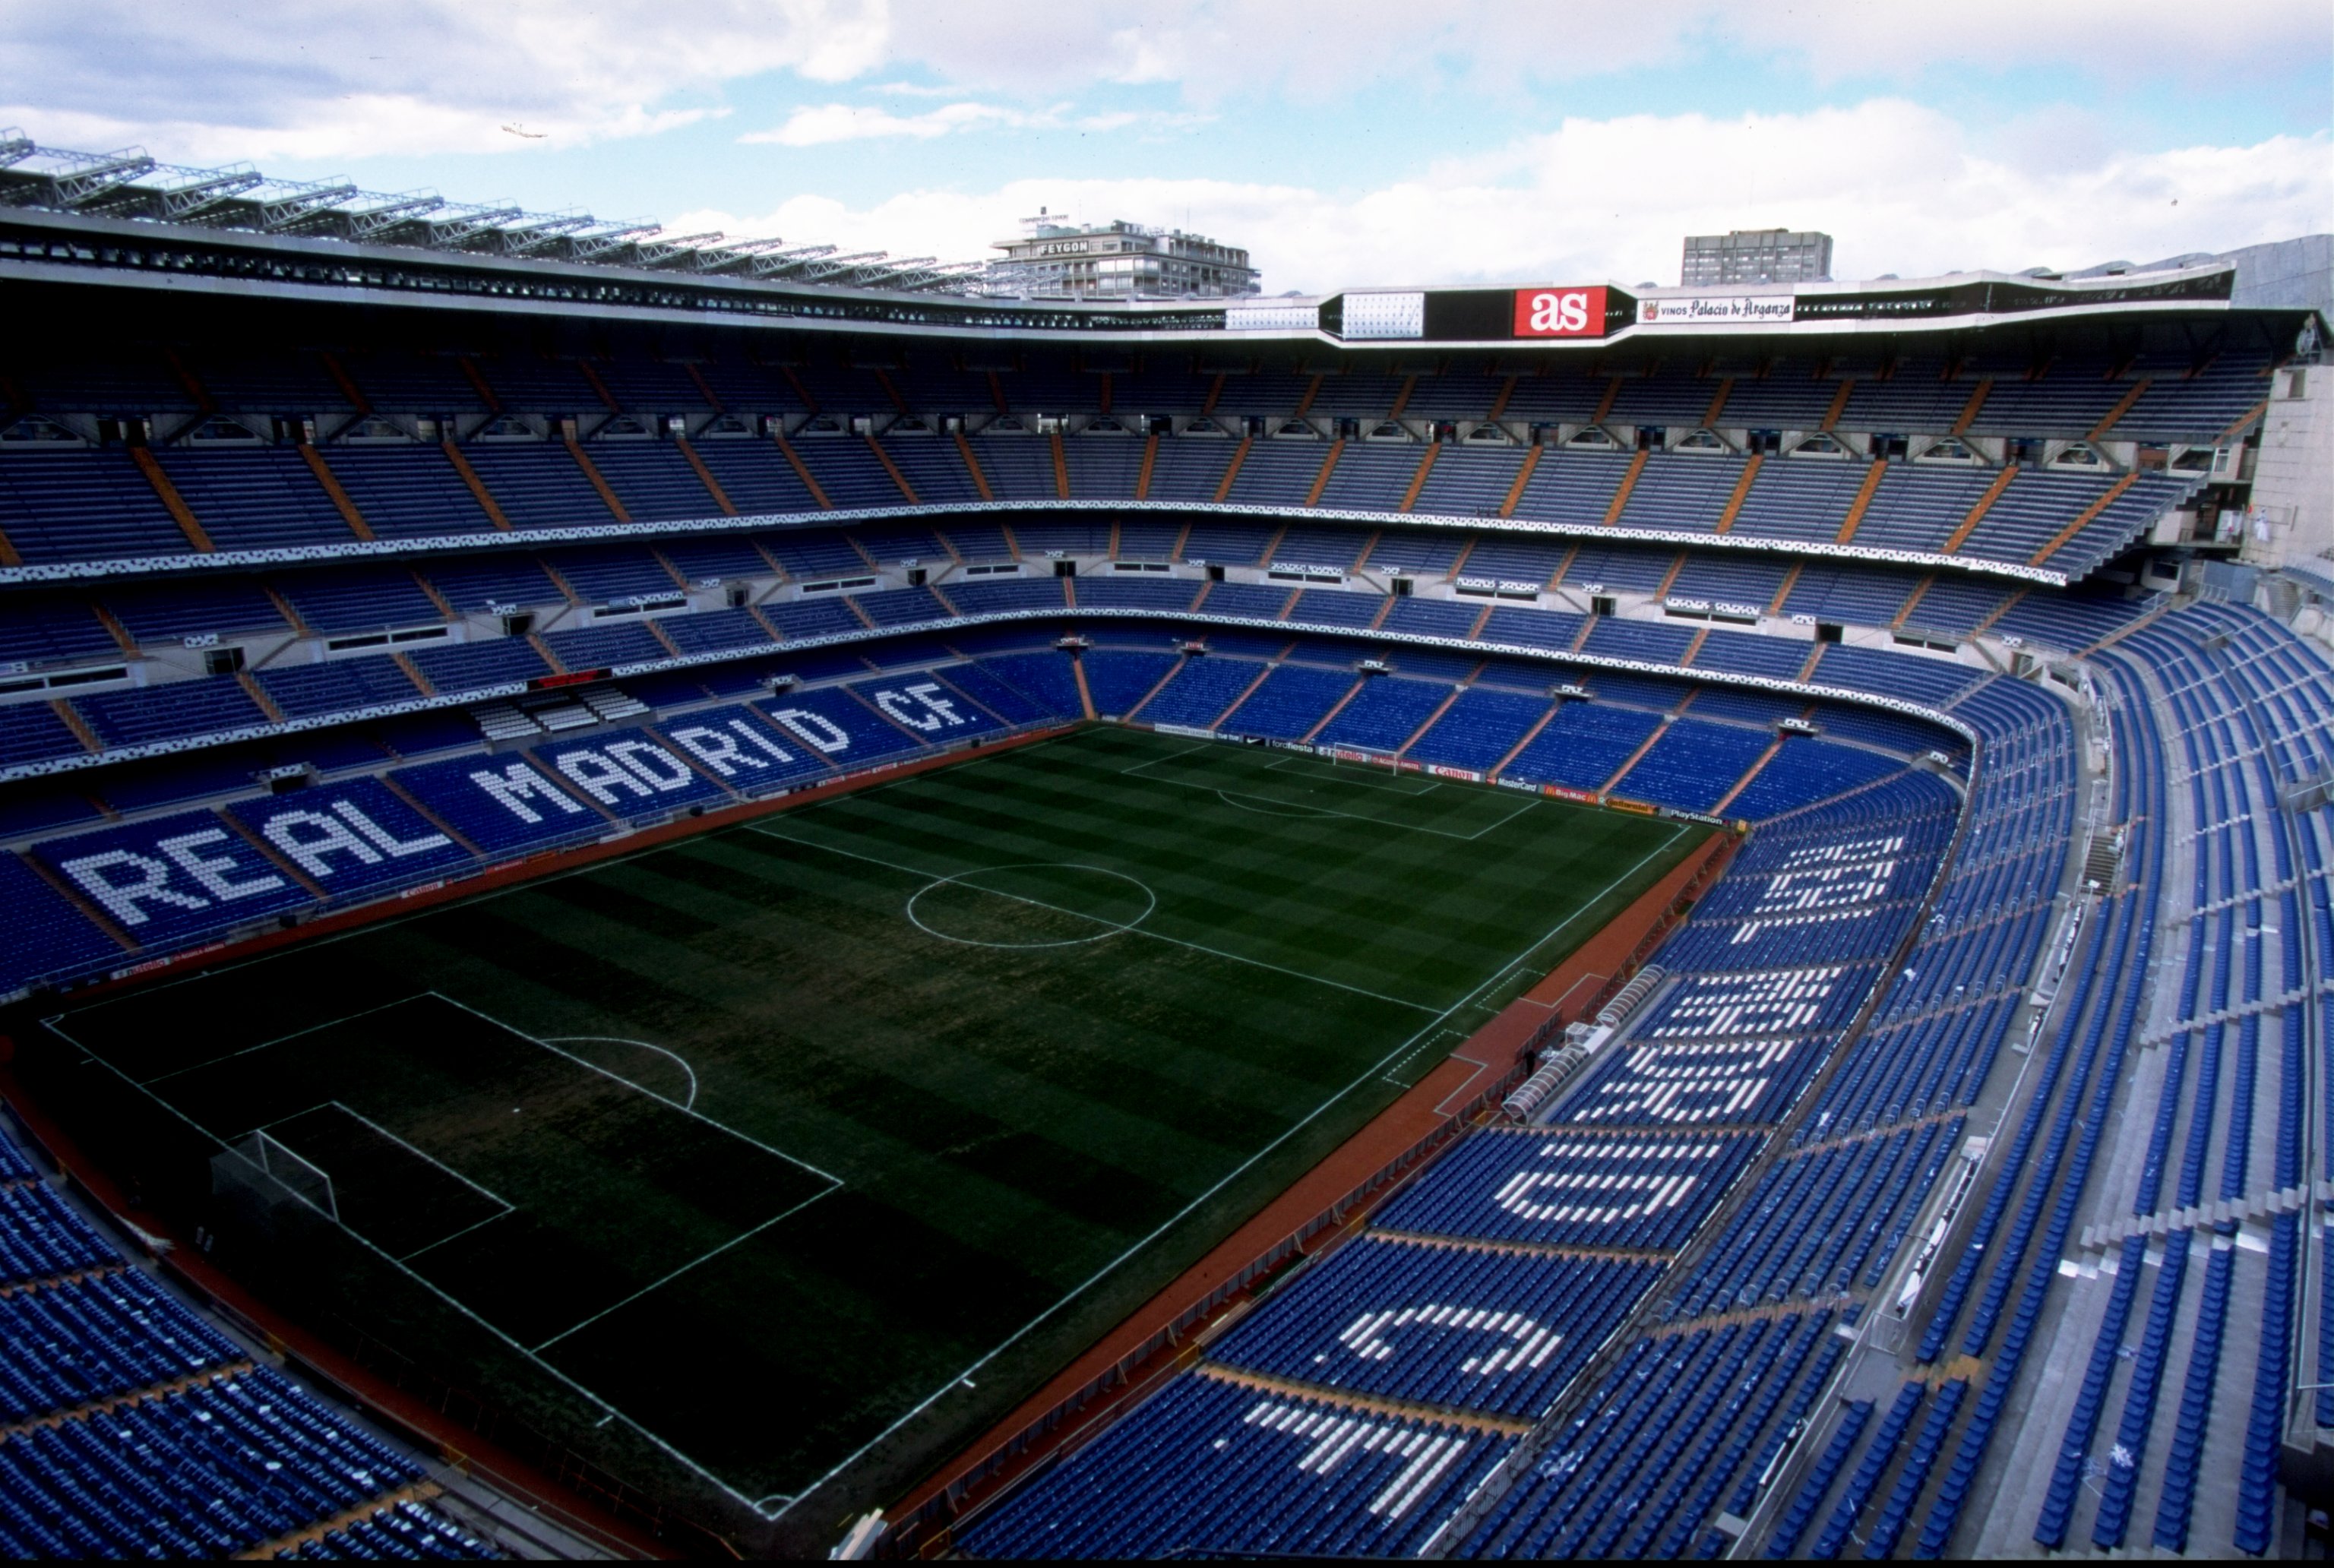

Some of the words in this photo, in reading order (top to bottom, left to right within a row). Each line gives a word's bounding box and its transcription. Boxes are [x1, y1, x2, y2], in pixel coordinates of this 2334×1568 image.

[1041, 242, 1087, 254] FEYGON
[1530, 293, 1588, 331] as
[1661, 307, 1687, 315] VINOS
[1688, 299, 1728, 318] Palacio
[1731, 299, 1741, 315] de
[1741, 296, 1791, 319] Arganza
[1435, 766, 1473, 781] Canon
[1497, 777, 1537, 792] MasterCard
[1555, 789, 1569, 799] Big
[1569, 791, 1586, 801] Mac
[1605, 797, 1649, 813] Continental
[62, 800, 452, 926] REAL
[470, 707, 850, 824] MADRID
[1671, 809, 1723, 825] PlayStation
[407, 883, 438, 896] Canon
